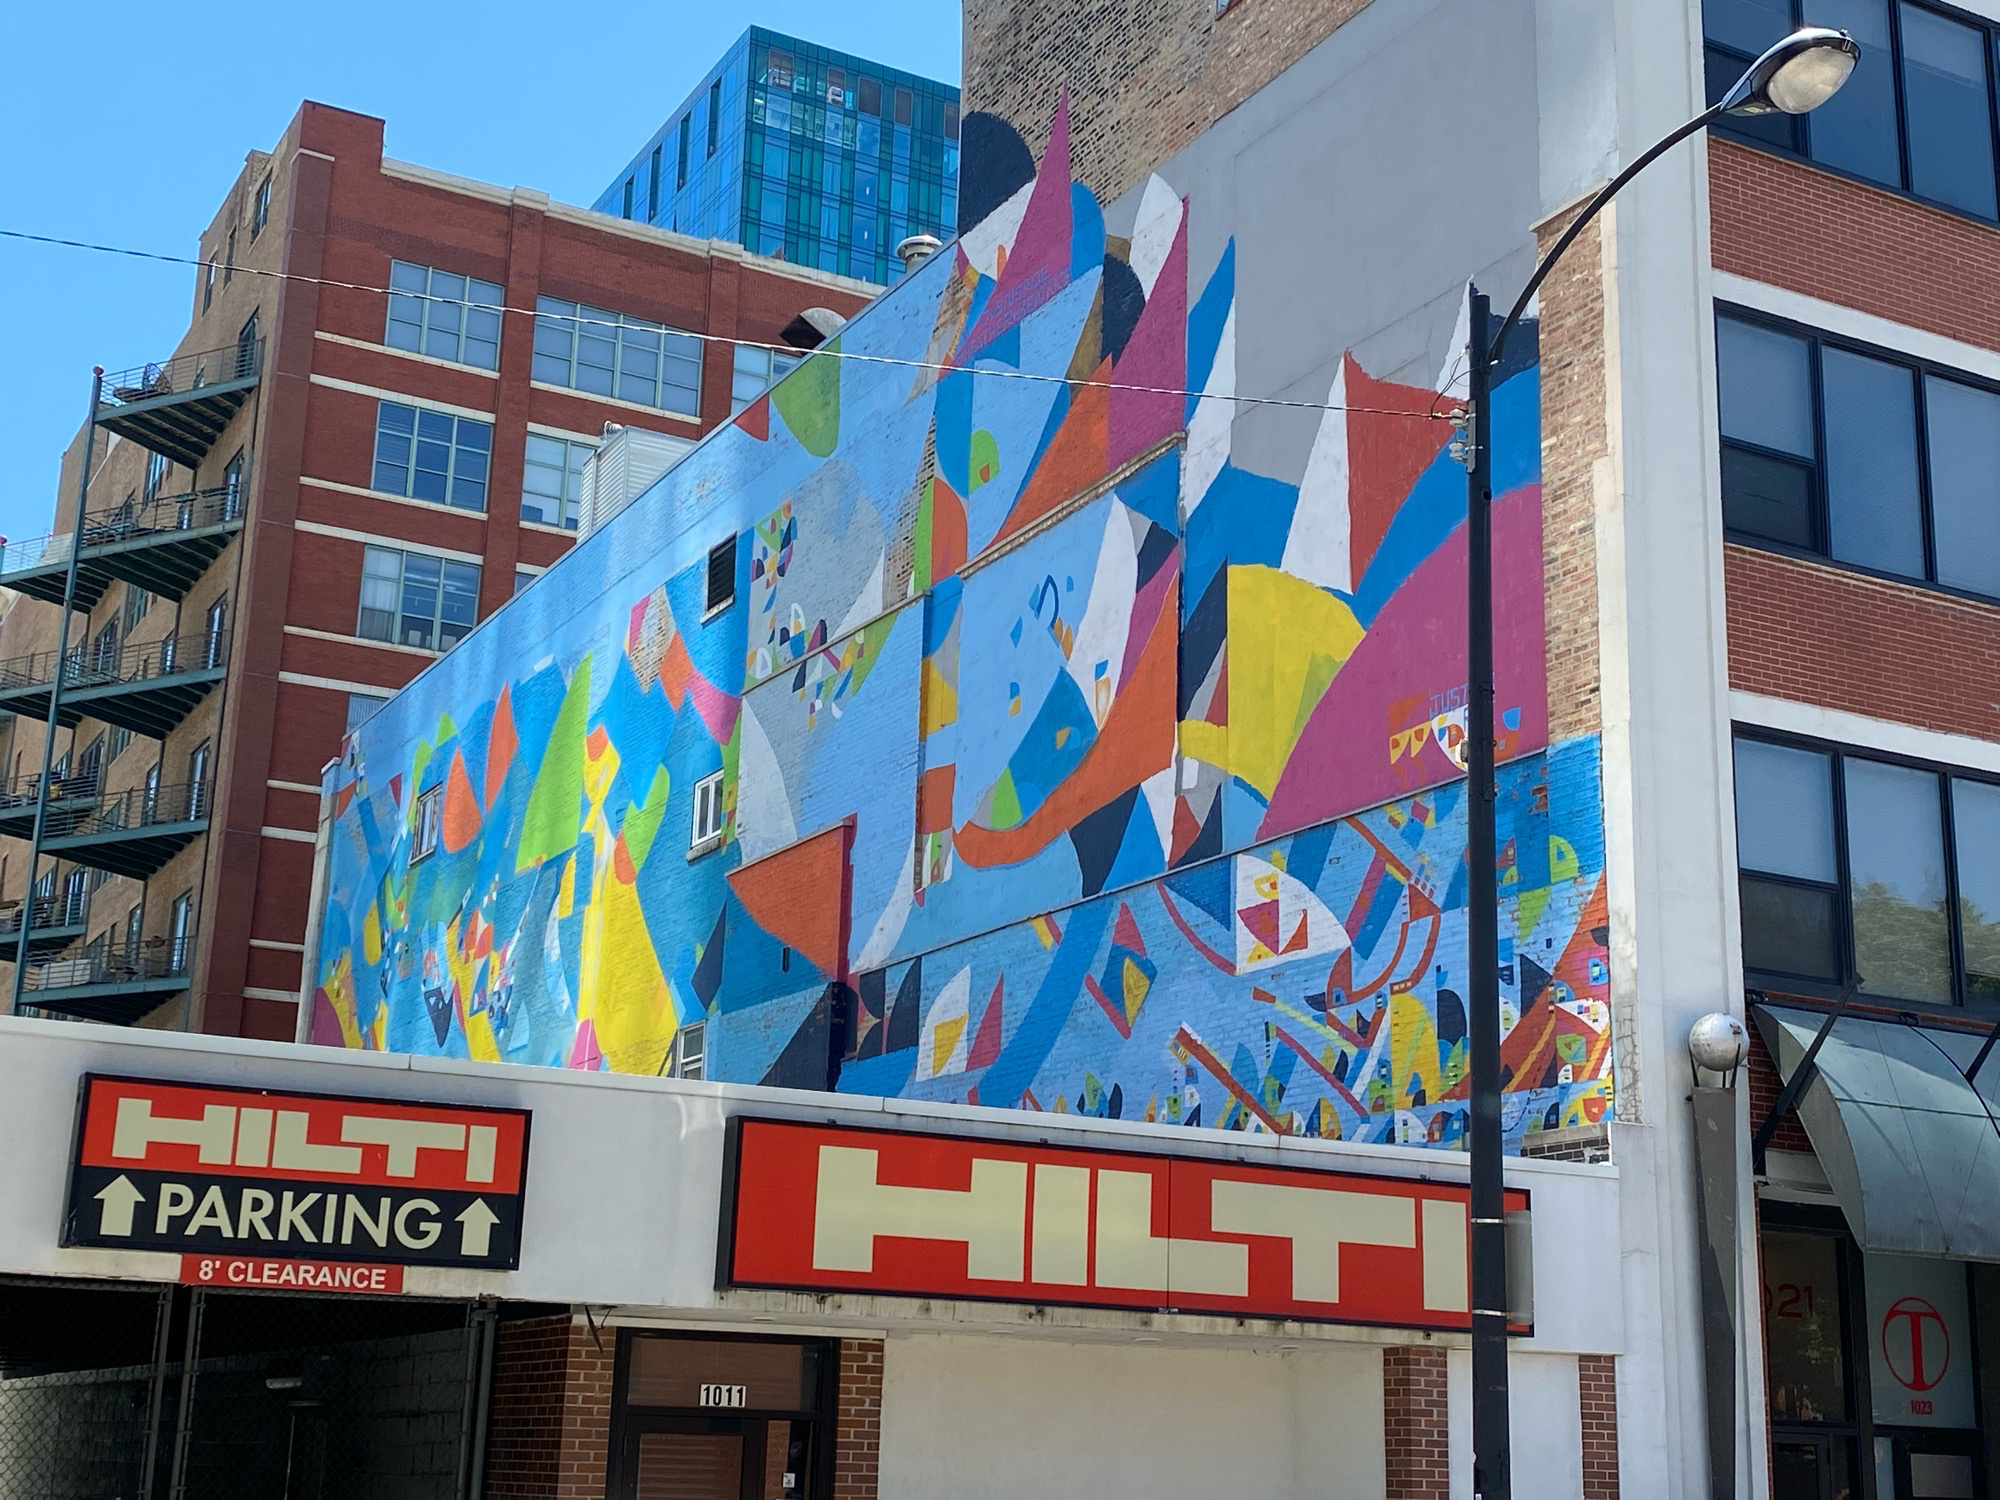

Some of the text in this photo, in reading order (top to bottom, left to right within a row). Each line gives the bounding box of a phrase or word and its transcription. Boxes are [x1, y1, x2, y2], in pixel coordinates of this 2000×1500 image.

[112, 1096, 498, 1183] HILTI
[155, 1182, 442, 1249] PARKING
[812, 1145, 1467, 1312] HILTI
[198, 1260, 386, 1290] 8' CLEARANCE
[702, 1384, 746, 1408] 1011
[1911, 1400, 1933, 1415] 1023
